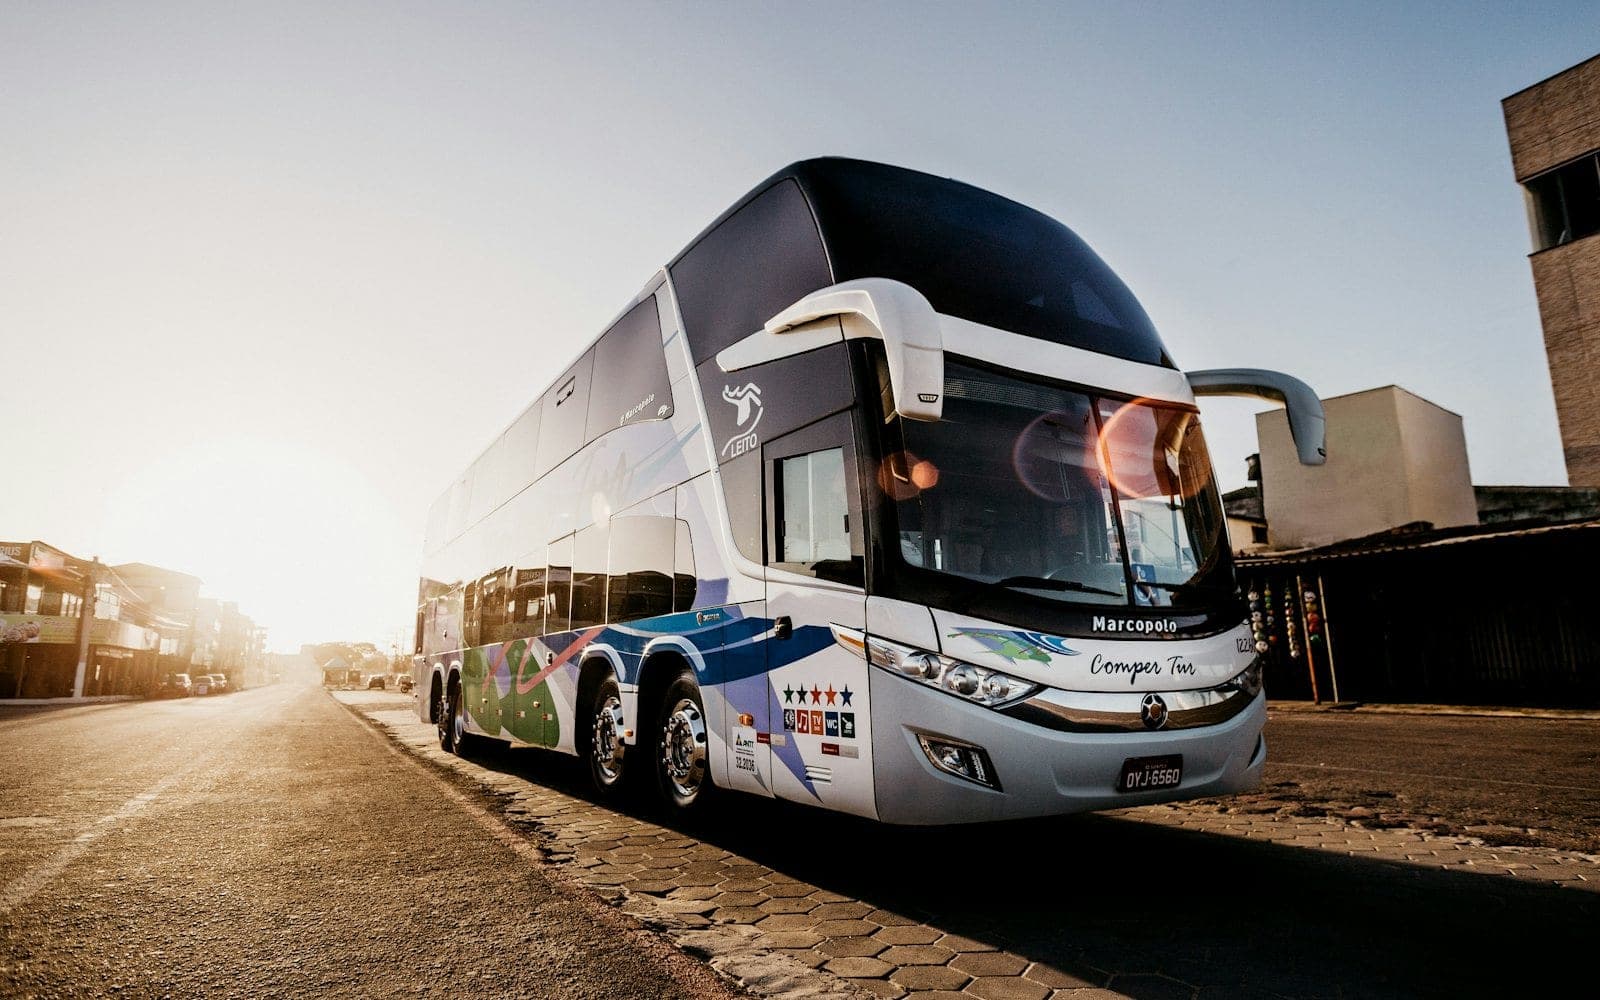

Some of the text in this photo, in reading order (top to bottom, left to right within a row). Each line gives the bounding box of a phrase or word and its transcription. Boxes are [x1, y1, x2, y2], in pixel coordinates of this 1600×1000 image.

[731, 433, 757, 458] LEITO
[1092, 615, 1177, 634] Marcopolo
[1091, 654, 1196, 685] Comper Tur
[812, 715, 822, 725] TV
[826, 719, 838, 729] WC
